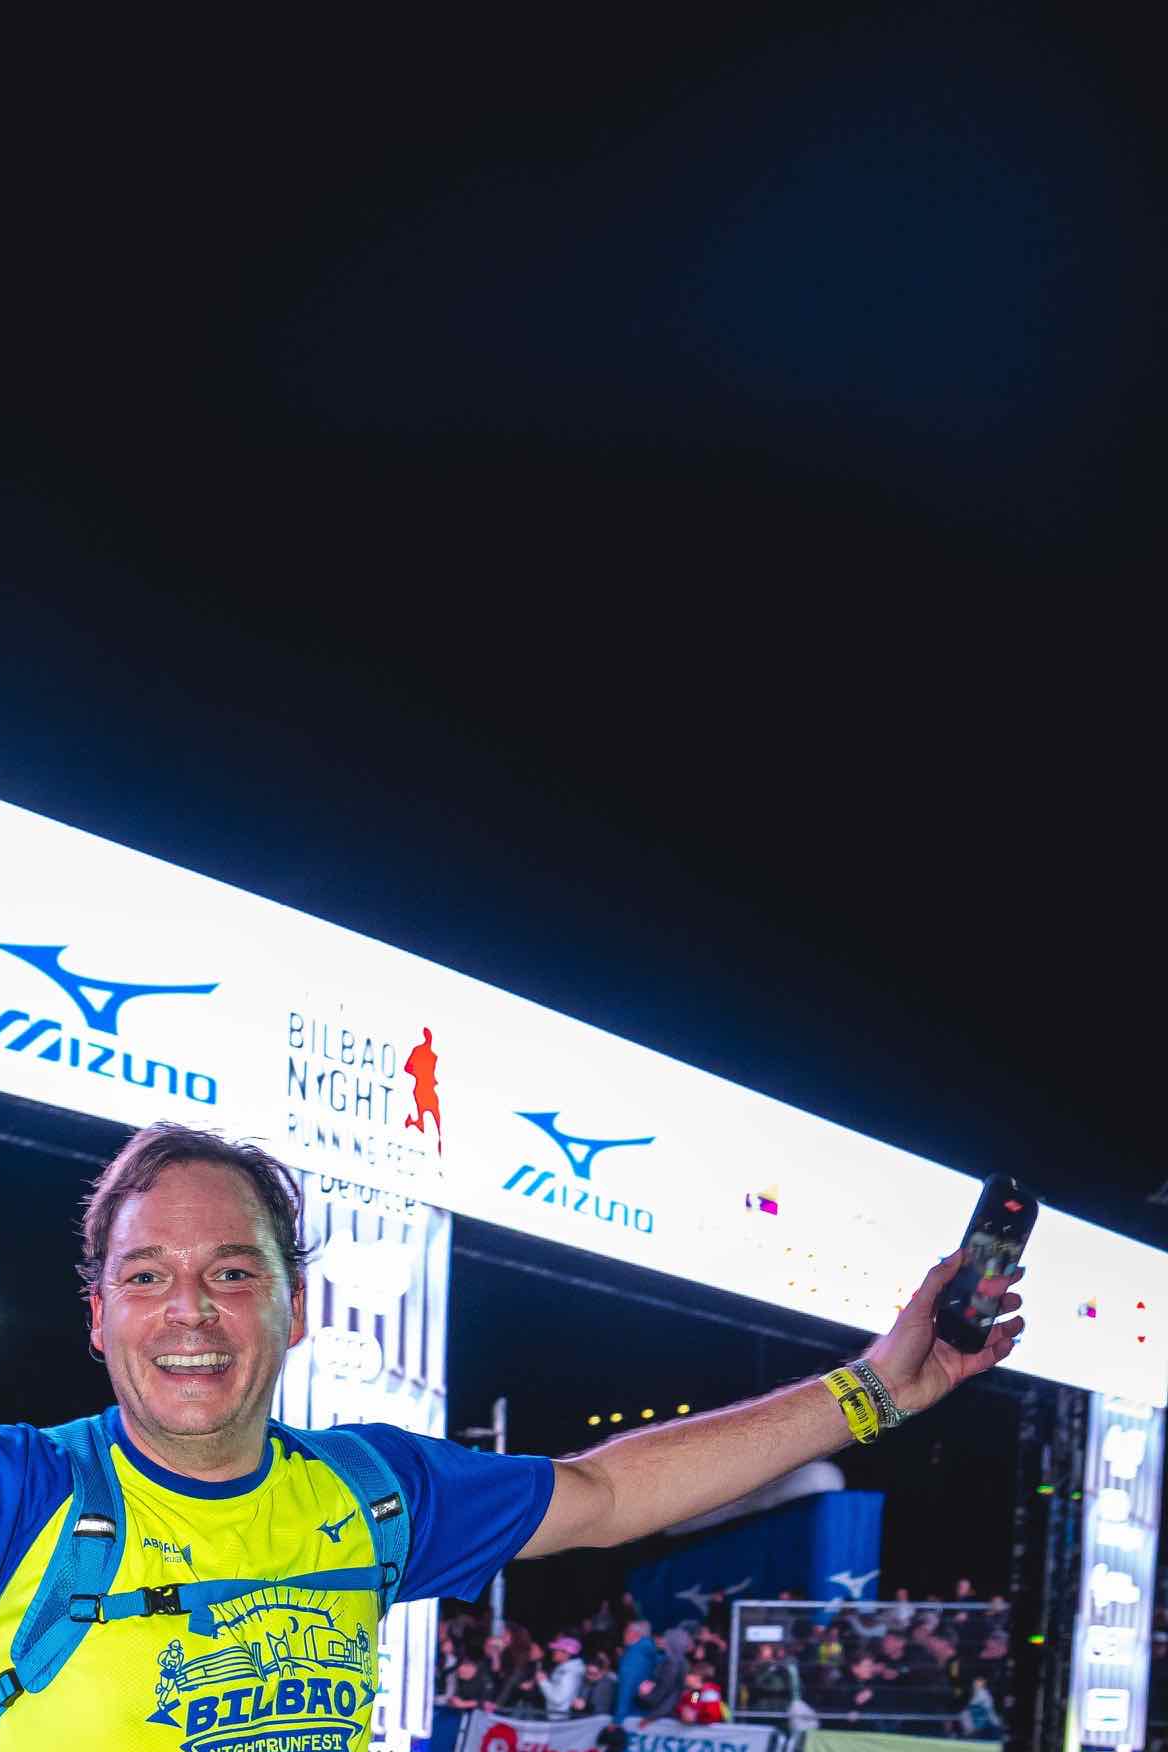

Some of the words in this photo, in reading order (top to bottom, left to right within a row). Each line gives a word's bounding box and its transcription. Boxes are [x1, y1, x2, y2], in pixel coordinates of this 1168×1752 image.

[288, 1011, 397, 1080] BILBAO
[502, 1164, 653, 1234] MIZUNO
[186, 1677, 357, 1737] BILBAO
